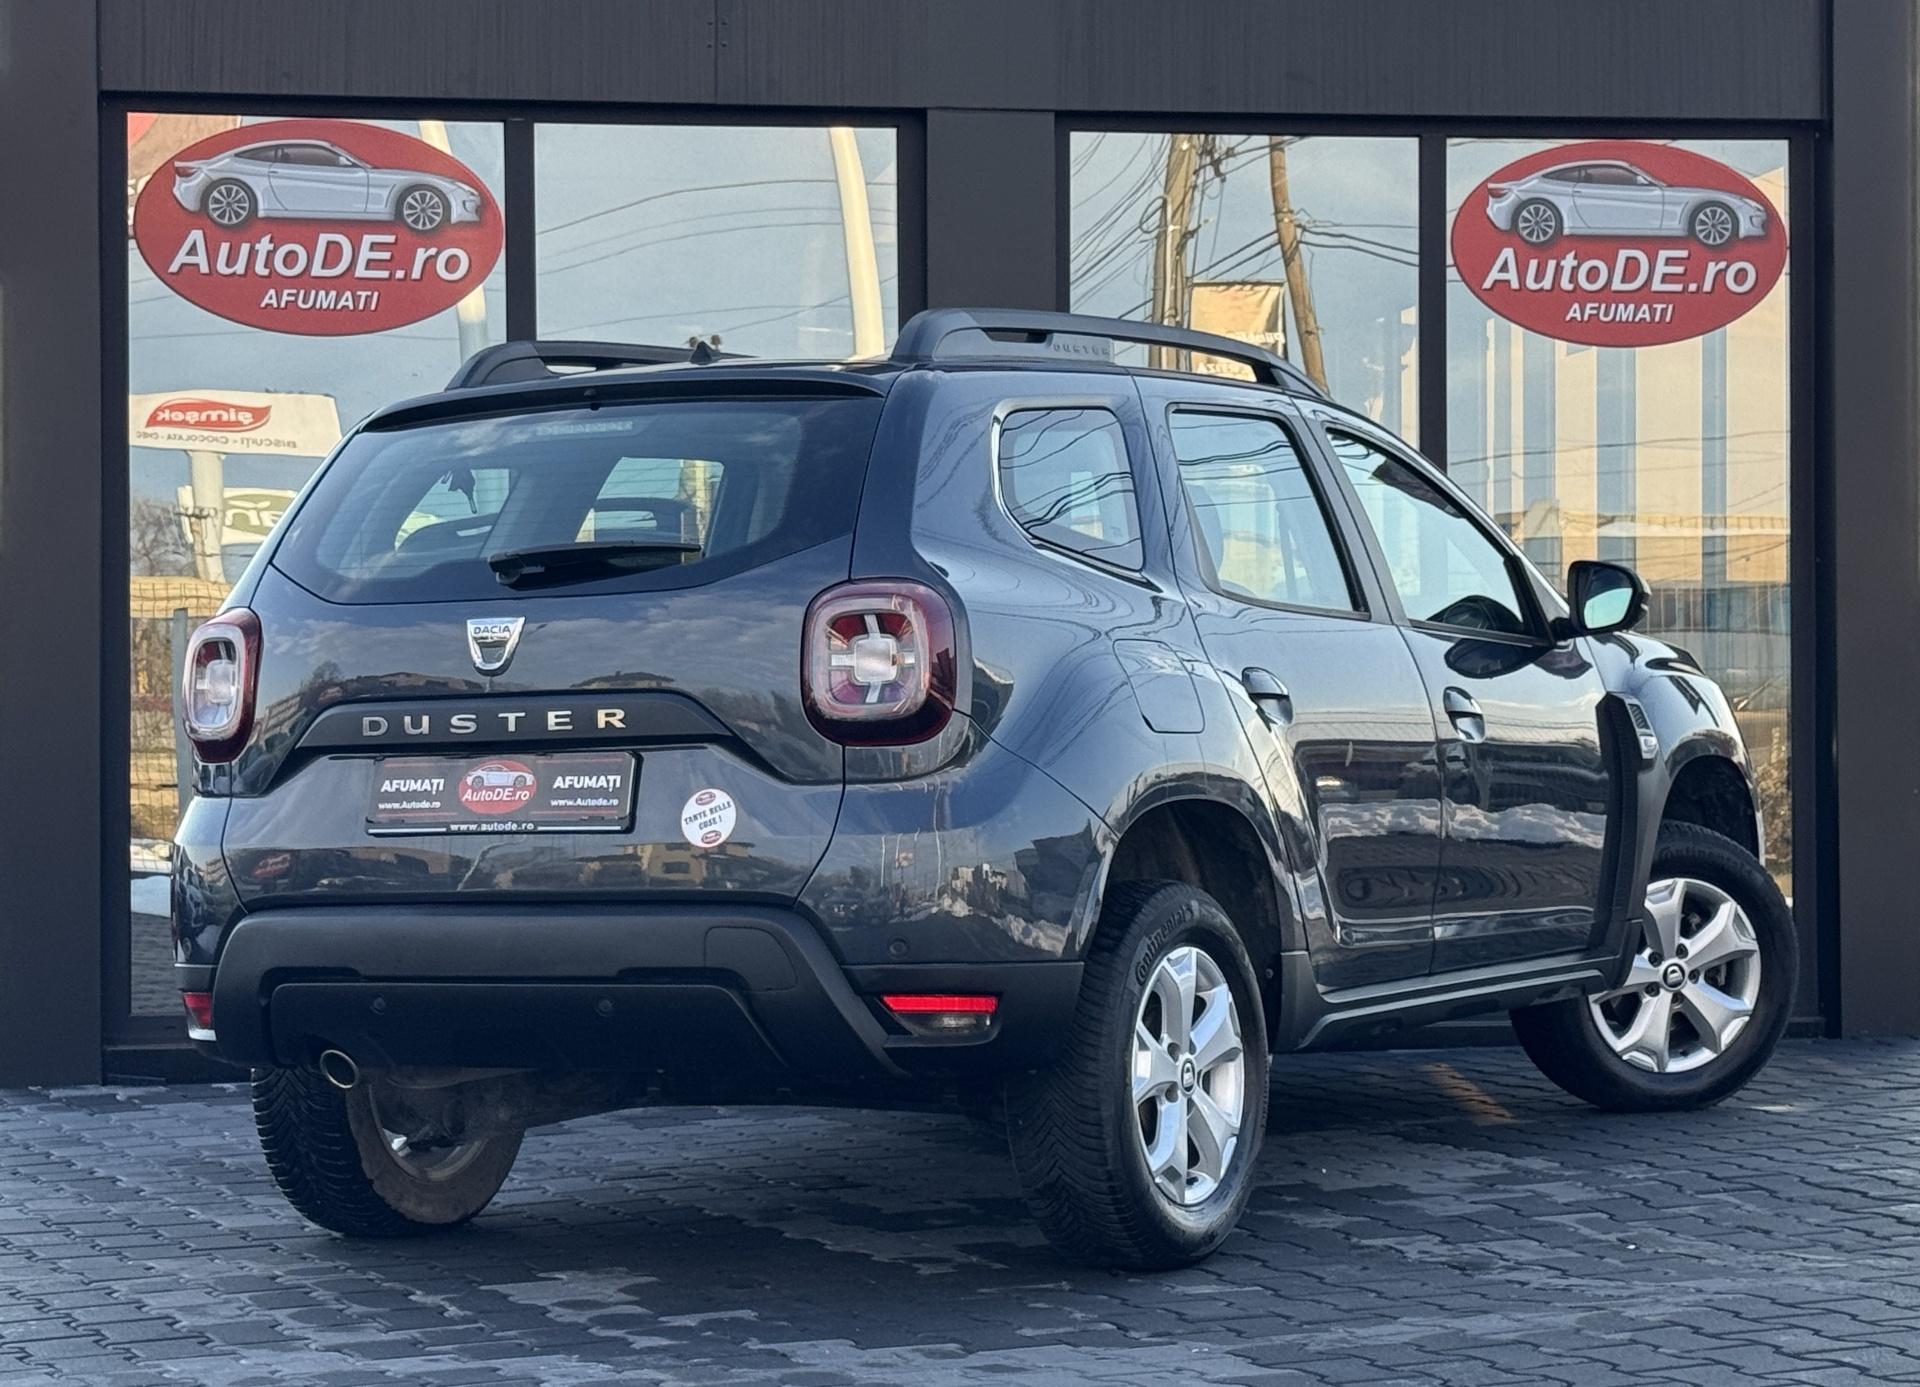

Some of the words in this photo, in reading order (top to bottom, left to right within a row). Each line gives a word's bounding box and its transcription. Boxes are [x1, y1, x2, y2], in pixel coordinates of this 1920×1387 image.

[167, 229, 471, 283] AutoDE.ro
[1481, 247, 1759, 294] AutoDE.ro
[259, 288, 380, 313] AFUMATI
[1564, 302, 1675, 324] AFUMATI
[473, 625, 512, 635] DACIA
[361, 708, 627, 737] DUSTER
[461, 787, 531, 803] AutoDE.ro
[449, 821, 535, 833] www.autode.ro
